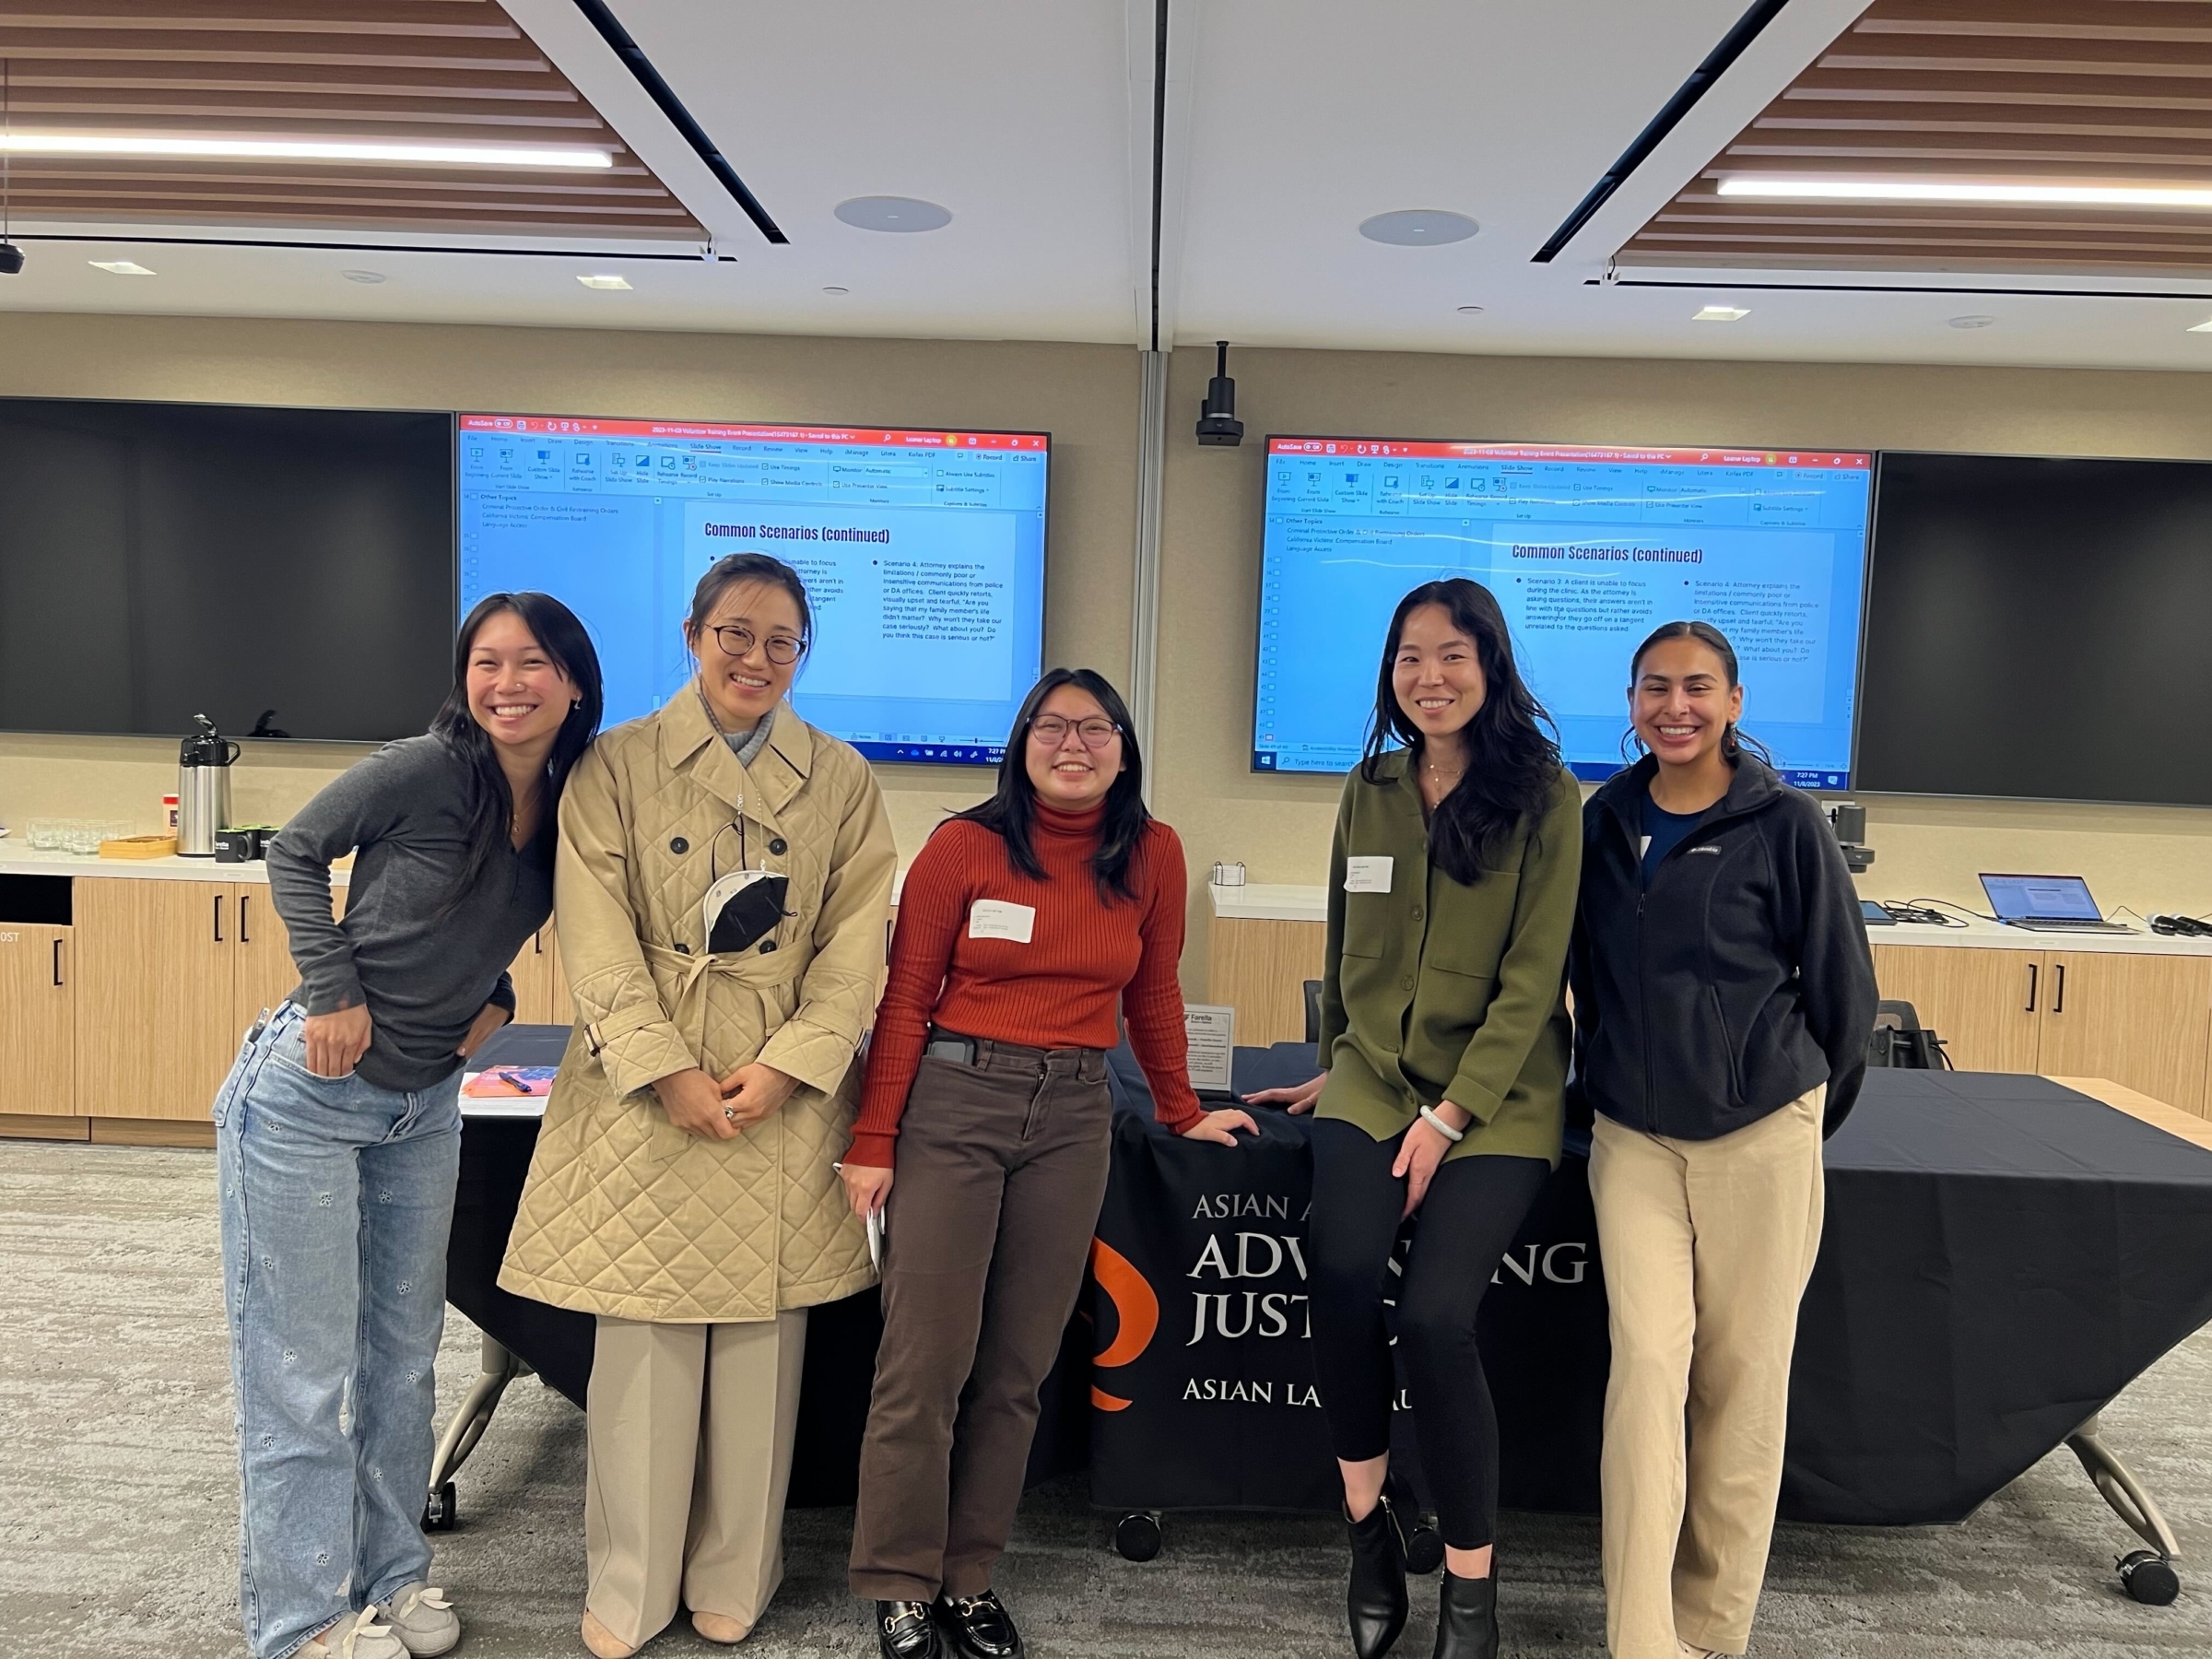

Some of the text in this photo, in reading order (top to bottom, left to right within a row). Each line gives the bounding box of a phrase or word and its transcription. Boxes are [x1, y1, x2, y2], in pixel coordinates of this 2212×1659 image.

[705, 523, 889, 545] Common Scenarios (continued)
[819, 559, 837, 568] focus
[1512, 545, 1702, 564] Common Scenarios (continued)
[917, 580, 967, 588] communications
[1295, 759, 1309, 767] Type
[1192, 1194, 1289, 1220] ASIAN
[1182, 1377, 1324, 1408] ASIAN LA
